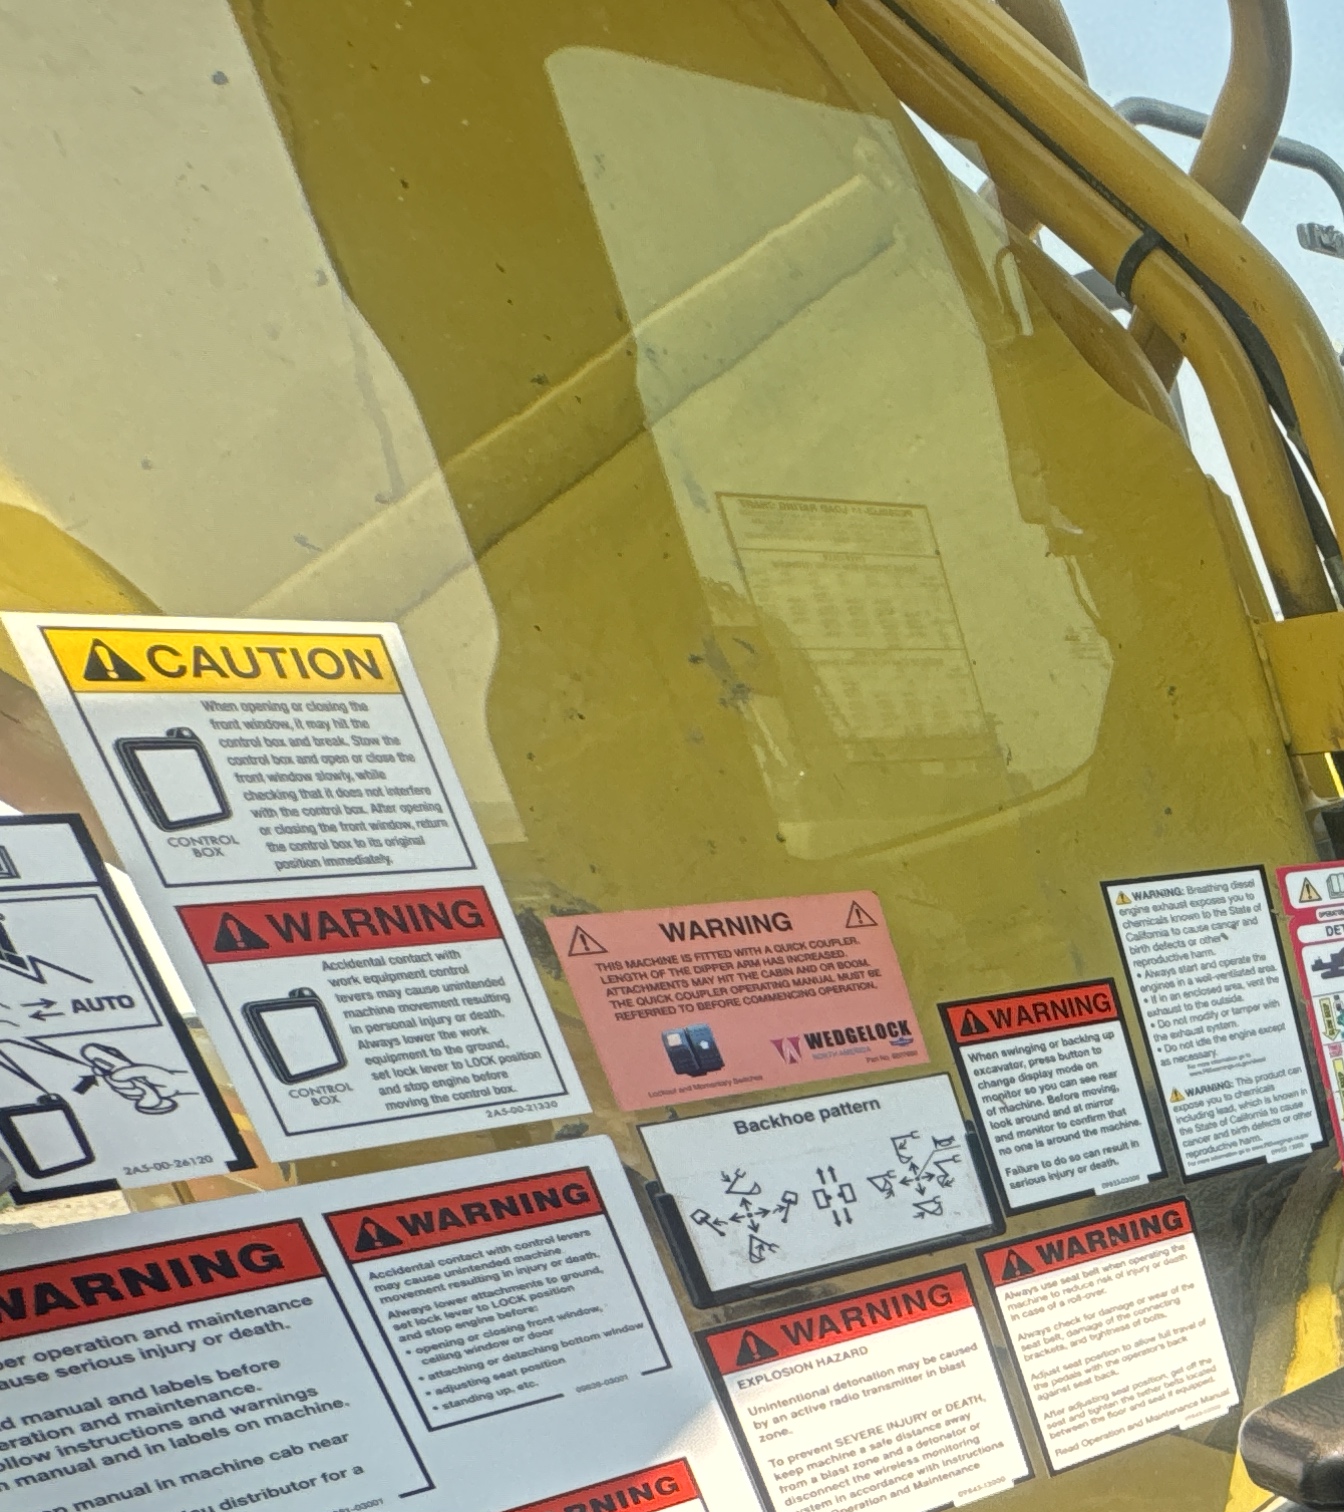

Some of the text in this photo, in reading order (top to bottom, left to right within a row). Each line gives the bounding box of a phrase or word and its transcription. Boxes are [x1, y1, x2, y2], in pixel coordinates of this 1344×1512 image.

[146, 644, 383, 680] CAUTION
[199, 700, 369, 714] When opening or closing the
[166, 834, 239, 847] CONTROL
[191, 846, 224, 857] BOX
[264, 899, 485, 943] WARNING
[658, 911, 793, 942] WARNING
[321, 949, 461, 971] Accidental contact with
[327, 963, 469, 987] work equipment control
[71, 994, 136, 1014] AUTO
[987, 992, 1111, 1029] WARNING
[803, 1019, 911, 1049] WEDGELOCK
[967, 1031, 1114, 1062] When swinging or backing up
[973, 1046, 1102, 1076] excavator, press button to
[977, 1061, 1098, 1090] change display mode on
[287, 1082, 353, 1098] CONTROL
[310, 1094, 339, 1106] BOX
[733, 1098, 882, 1136] Backhoe pattern
[395, 1182, 590, 1236] WARNING
[368, 1229, 591, 1280] Accidental contact with control levers
[1035, 1209, 1183, 1264] WARNING
[392, 1284, 575, 1331] set lock lever to LOCK position
[779, 1282, 952, 1345] WARNING
[32, 1296, 313, 1362] operation and maintenance
[54, 1353, 135, 1377] serious
[137, 1339, 195, 1359] injury
[202, 1333, 222, 1345] or
[228, 1319, 290, 1340] death.
[434, 1357, 566, 1395] adjusting seat position
[736, 1345, 868, 1389] EXPLOSION HAZARD
[747, 1342, 978, 1416] Unintentional detonation may be caused
[20, 1359, 280, 1425] manual and labels before
[79, 1412, 121, 1432] and
[124, 1383, 262, 1421] maintenance.
[54, 1420, 183, 1457] instructions
[187, 1407, 226, 1425] and
[228, 1387, 318, 1415] warnings
[767, 1393, 986, 1467] To prevent SEVERE INJURY or DEATH,
[13, 1399, 349, 1487] manual and in labels on machine.
[72, 1481, 152, 1511] manual
[154, 1478, 176, 1490] in
[178, 1456, 264, 1484] machine
[268, 1444, 303, 1460] cab
[307, 1433, 348, 1450] near
[218, 1477, 317, 1510] distributor
[320, 1469, 347, 1483] for
[351, 1465, 364, 1475] a
